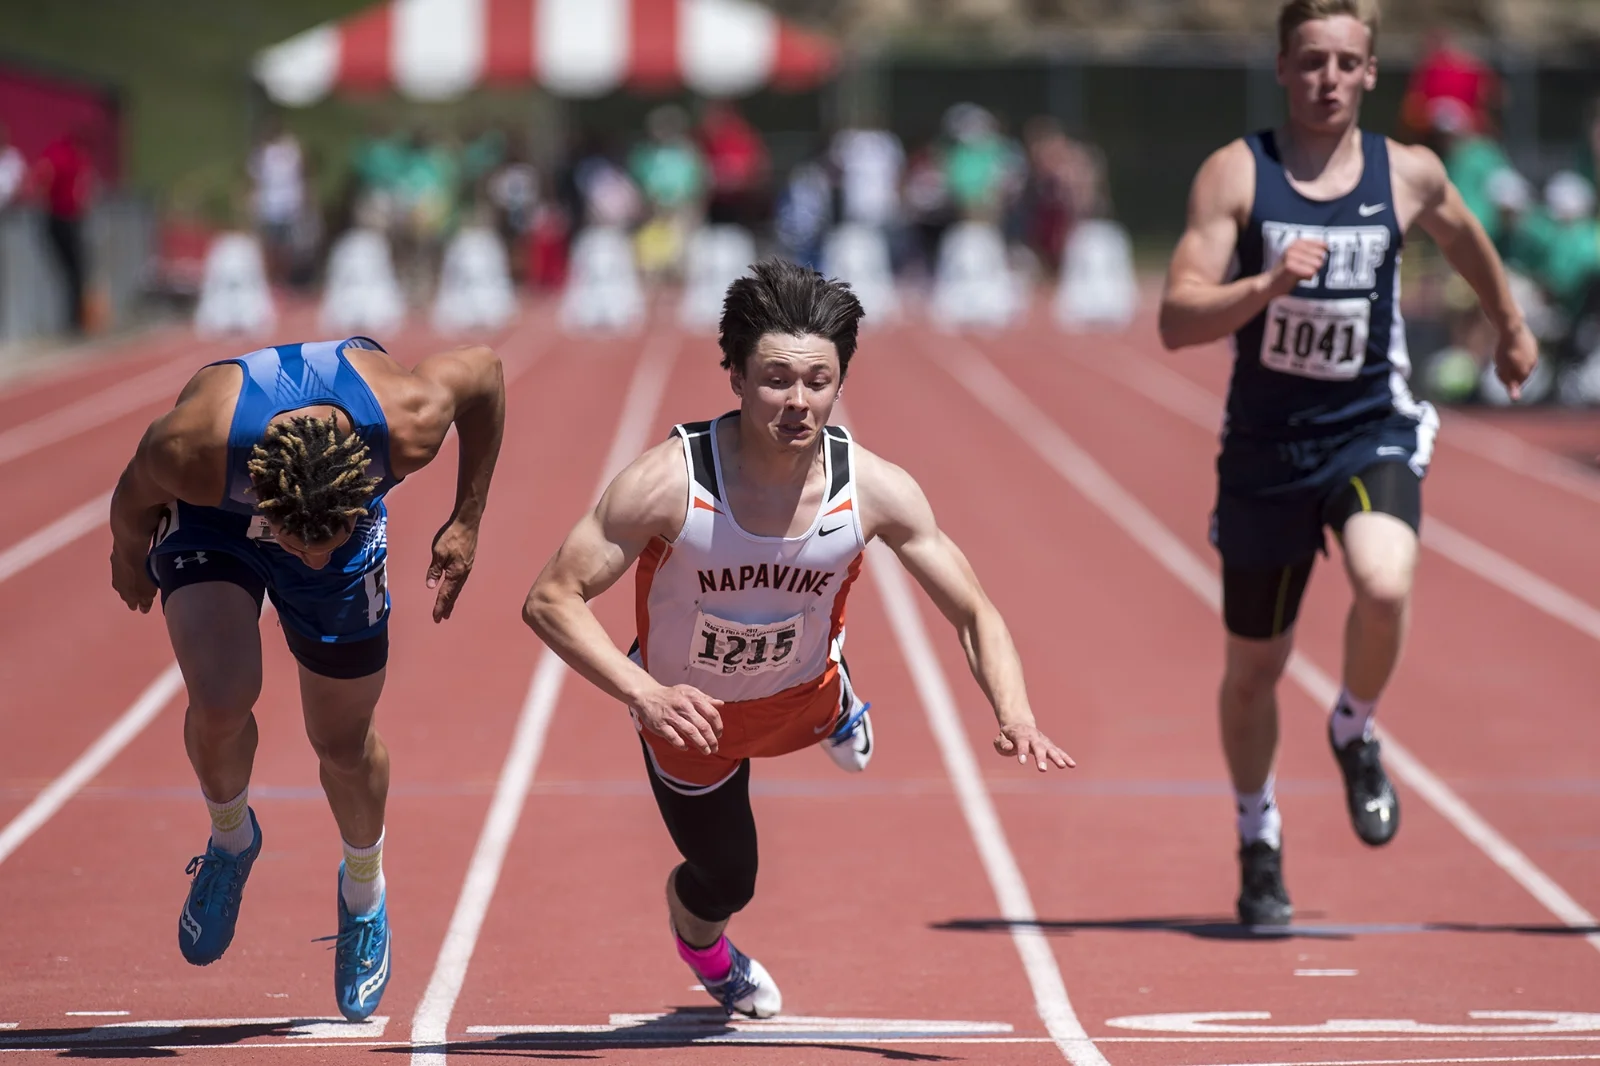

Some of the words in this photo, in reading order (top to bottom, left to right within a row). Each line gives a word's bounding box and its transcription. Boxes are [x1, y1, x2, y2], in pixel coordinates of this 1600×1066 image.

[1270, 317, 1355, 362] 1041
[697, 563, 836, 597] NAPAVINE
[697, 628, 797, 666] 1215
